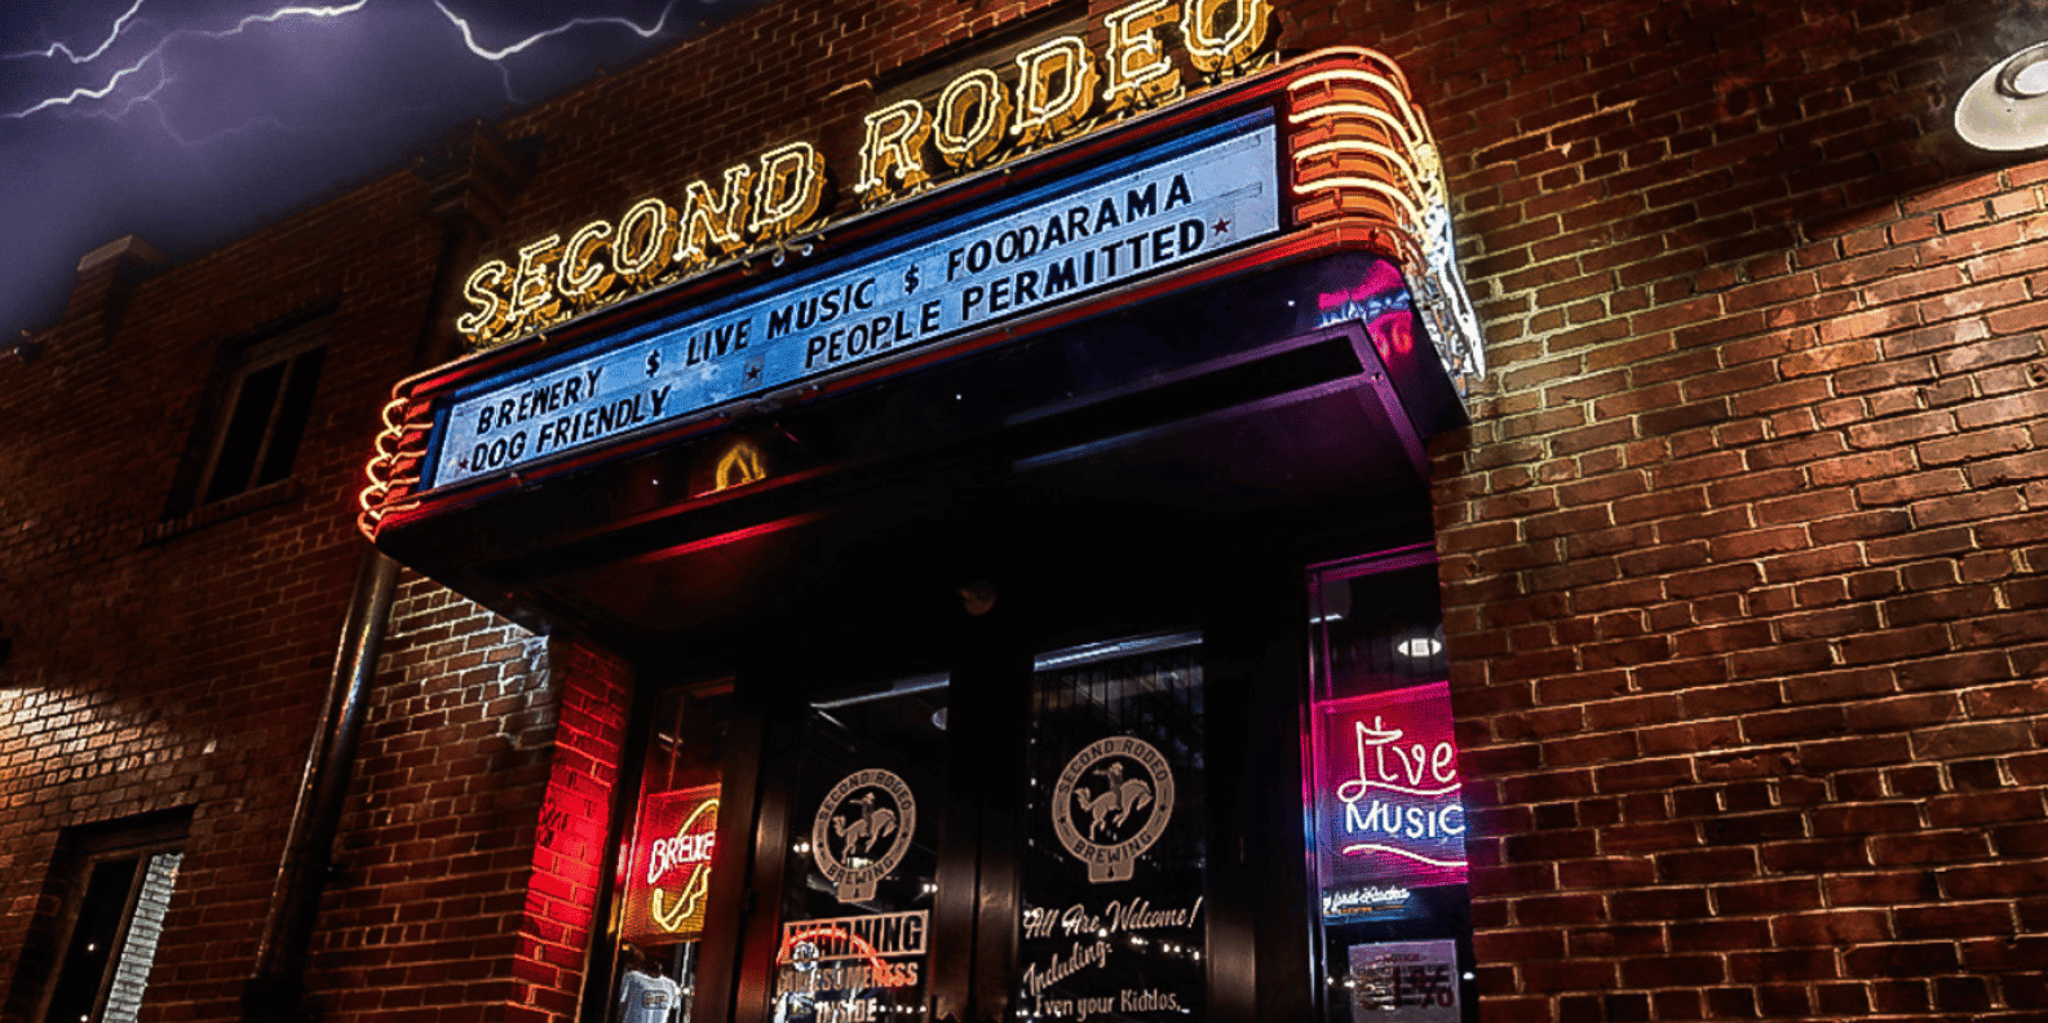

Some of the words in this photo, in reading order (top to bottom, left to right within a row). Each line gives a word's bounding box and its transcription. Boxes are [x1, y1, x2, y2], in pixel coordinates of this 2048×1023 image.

[457, 141, 824, 337] SECOND
[853, 0, 1270, 198] RODEO
[476, 367, 603, 436] BREWERY
[686, 317, 751, 367] LIVE
[767, 277, 876, 340] MUSIC
[947, 172, 1193, 282] FOODARAMA
[471, 430, 527, 473] DOG
[537, 385, 672, 453] FRIENDLY
[805, 300, 942, 369] PEOPLE
[962, 218, 1206, 321] PERMITTED
[1059, 740, 1115, 794] SECOND
[1122, 740, 1168, 783] RODEO
[1346, 800, 1466, 839] MUSIC
[1073, 832, 1153, 863] BREWING
[1023, 907, 1060, 939] All
[1061, 903, 1101, 937] Are
[1105, 896, 1203, 933] Welcome!
[1077, 997, 1120, 1022] your
